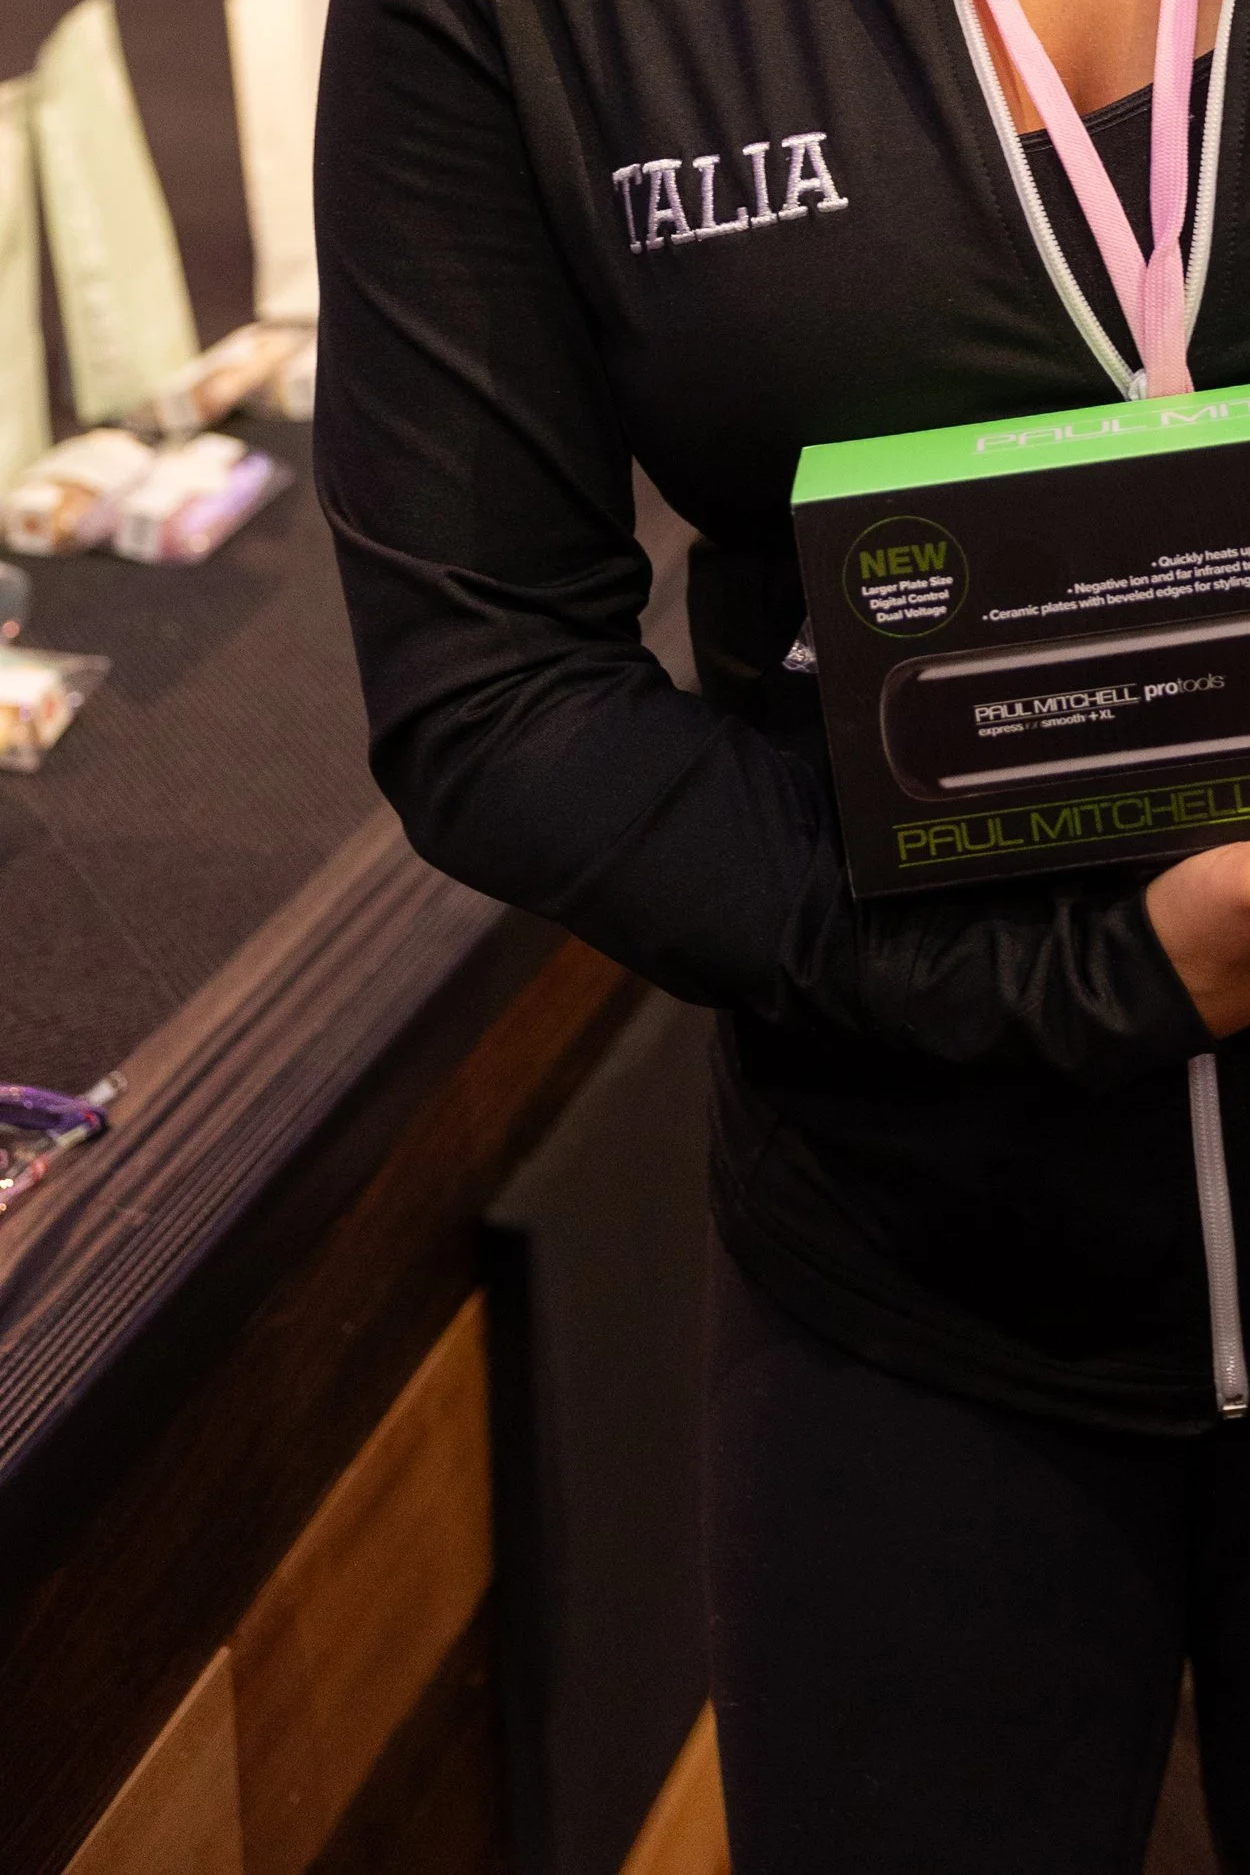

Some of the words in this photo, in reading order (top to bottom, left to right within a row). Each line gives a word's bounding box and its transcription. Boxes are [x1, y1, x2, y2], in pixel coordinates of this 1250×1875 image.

[612, 131, 849, 255] TALIA
[974, 417, 1142, 453] PAUL
[859, 541, 947, 580] NEW
[1158, 552, 1203, 568] Quickly
[1205, 547, 1239, 562] heats
[862, 583, 898, 597] Larger
[899, 579, 928, 591] Plate
[929, 575, 953, 587] Size
[1074, 577, 1128, 594] Negative
[1129, 575, 1149, 587] ion
[1151, 570, 1175, 584] and
[1175, 567, 1193, 580] far
[1194, 561, 1241, 577] infrared
[869, 594, 907, 610] Digital
[907, 589, 950, 604] Control
[876, 610, 904, 624] Dual
[904, 604, 948, 619] Voltage
[989, 604, 1040, 621] Ceramic
[1041, 601, 1077, 617] plates
[1078, 596, 1105, 610] with
[1106, 588, 1154, 605] beveled
[1156, 584, 1193, 599] edges
[1194, 580, 1211, 593] for
[974, 705, 1032, 722] PAUL
[1034, 686, 1140, 715] MITCHELL
[1144, 673, 1225, 702] protools
[978, 722, 1025, 738] express
[896, 816, 1024, 862] PAUL
